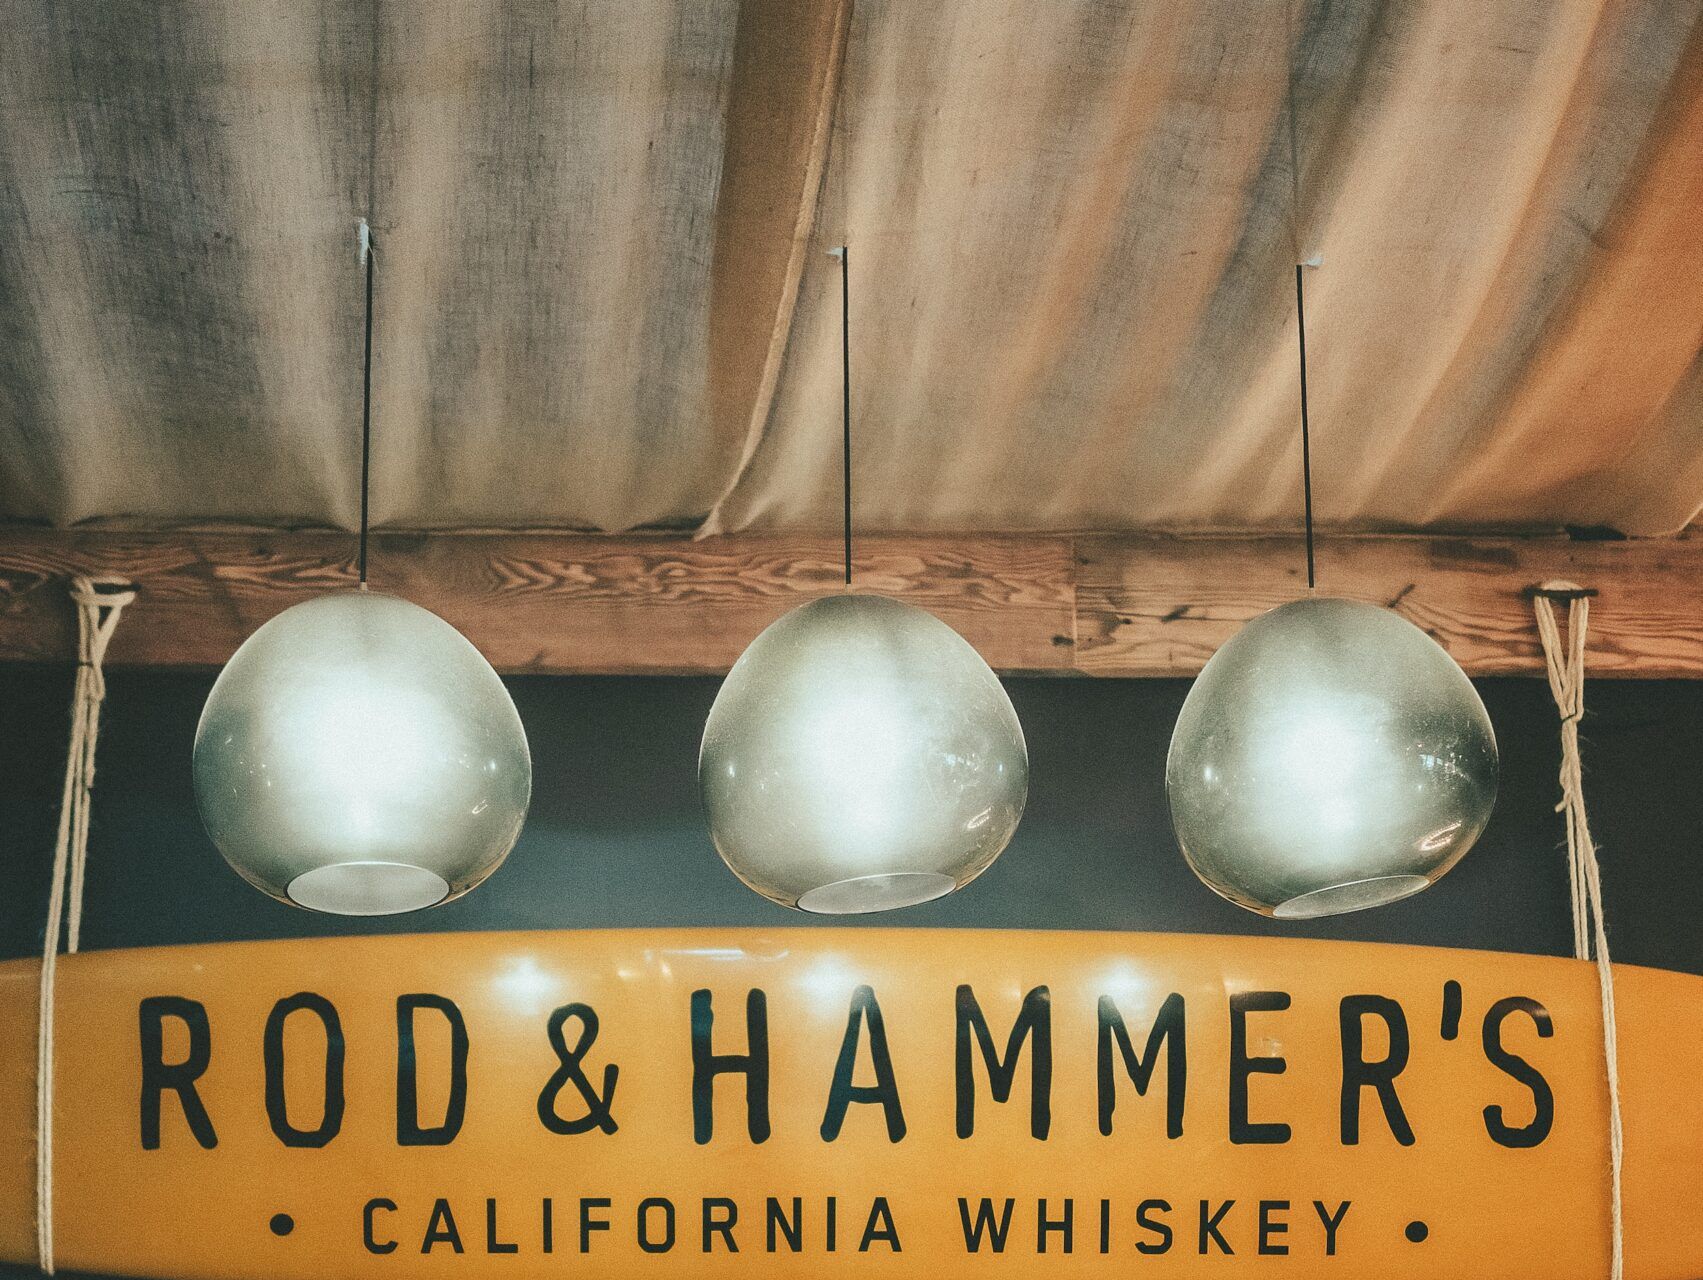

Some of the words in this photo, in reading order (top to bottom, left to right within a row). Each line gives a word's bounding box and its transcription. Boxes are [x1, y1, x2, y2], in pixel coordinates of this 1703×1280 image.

[138, 991, 470, 1151] ROD
[537, 1003, 619, 1136] &
[690, 980, 1555, 1149] HAMMER'S
[363, 1196, 902, 1255] CALIFORNIA
[957, 1197, 1352, 1256] WHISKEY
